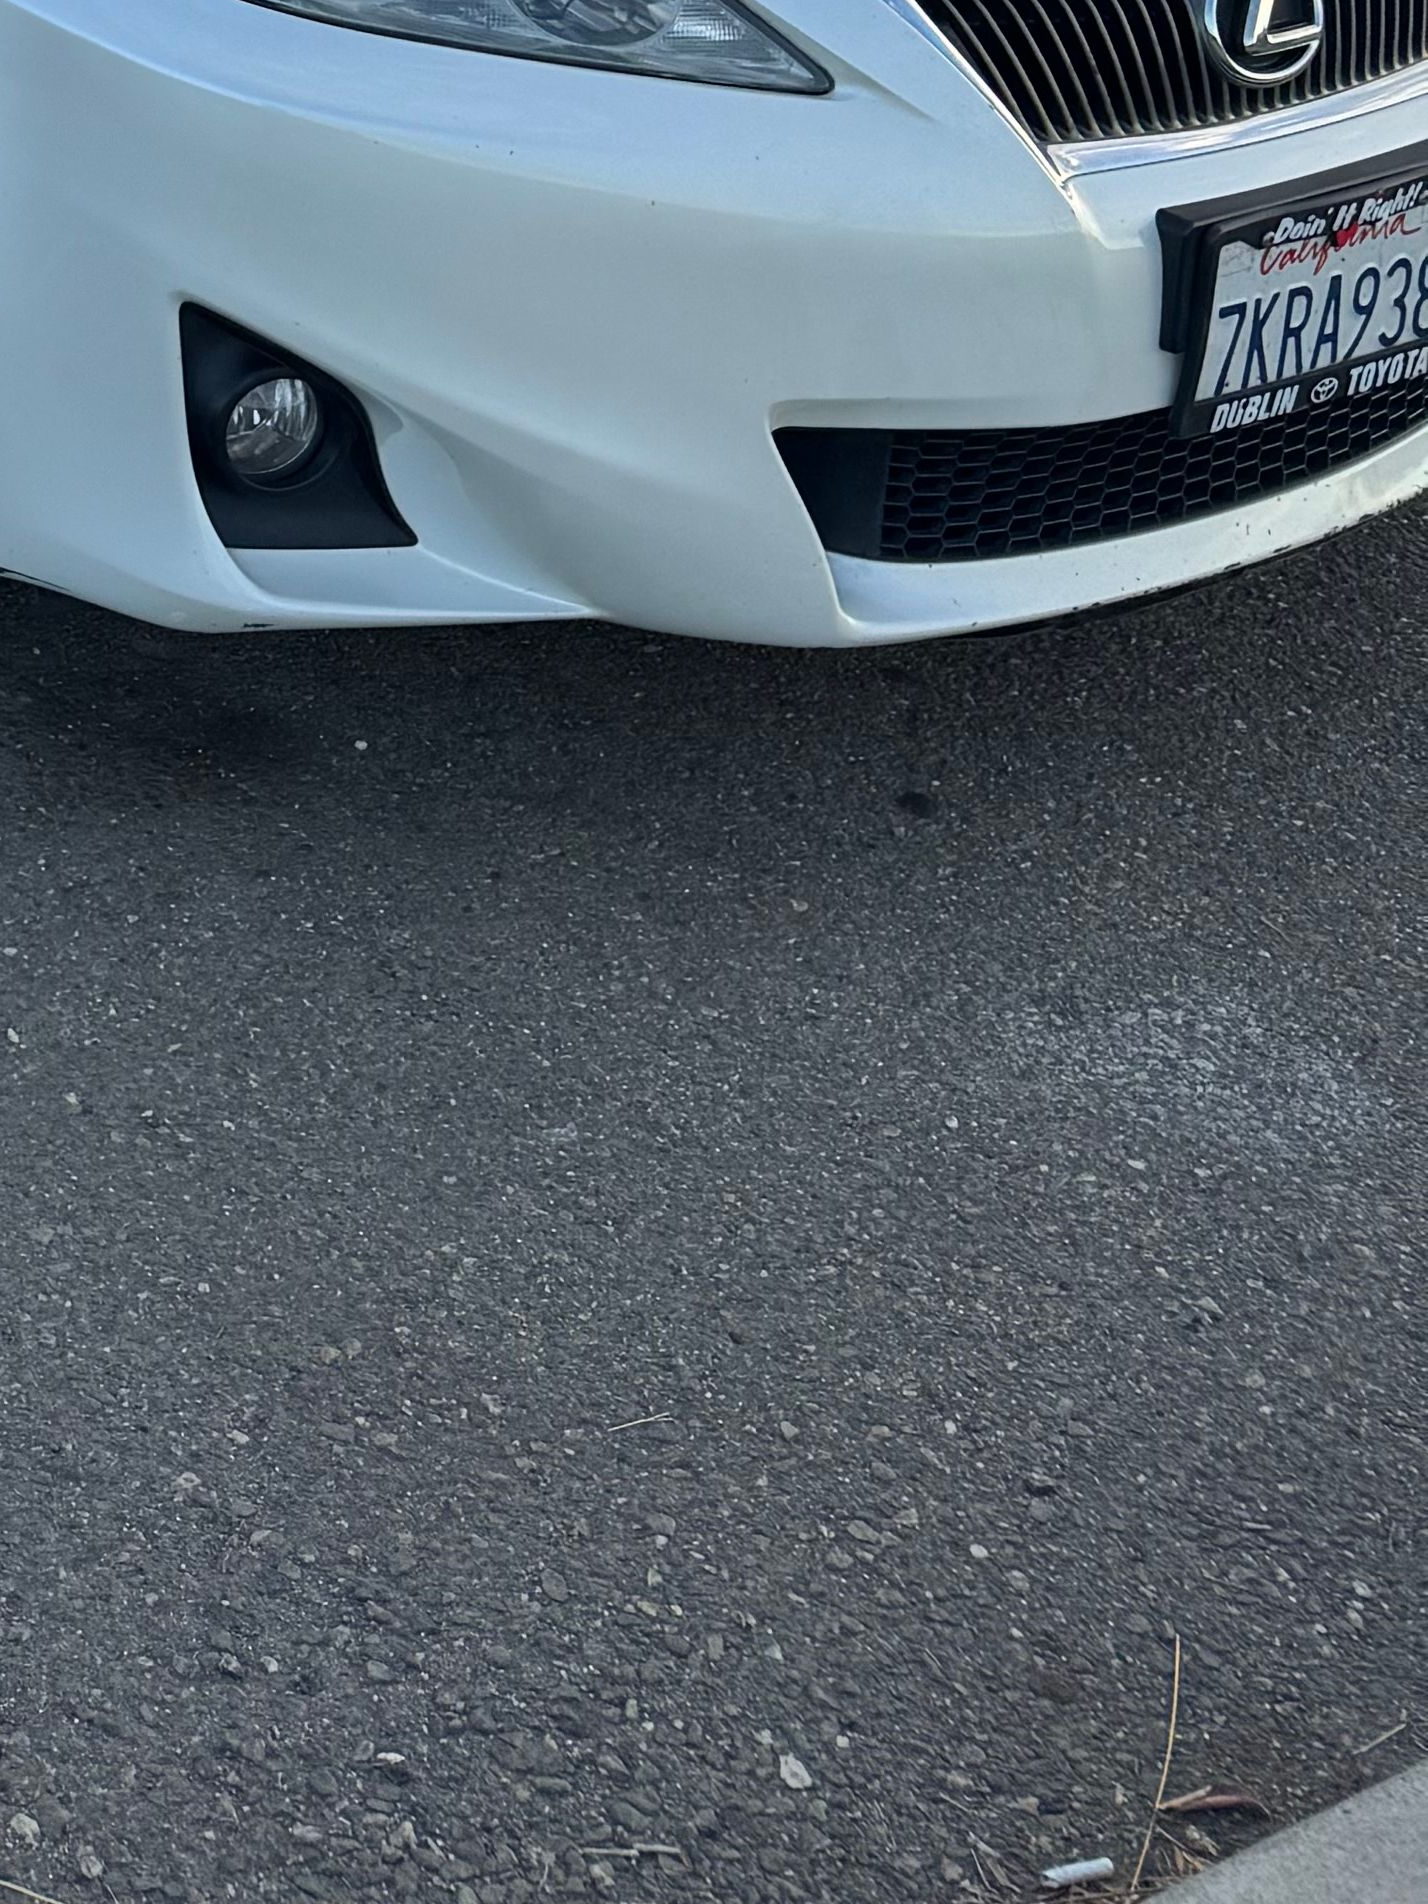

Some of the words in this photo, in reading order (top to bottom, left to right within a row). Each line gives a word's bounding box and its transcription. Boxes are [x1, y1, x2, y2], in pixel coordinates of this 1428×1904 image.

[1332, 202, 1357, 231] It
[1358, 181, 1424, 224] Right!
[1260, 212, 1421, 275] Califrnia
[1209, 384, 1300, 434] DUBLIN
